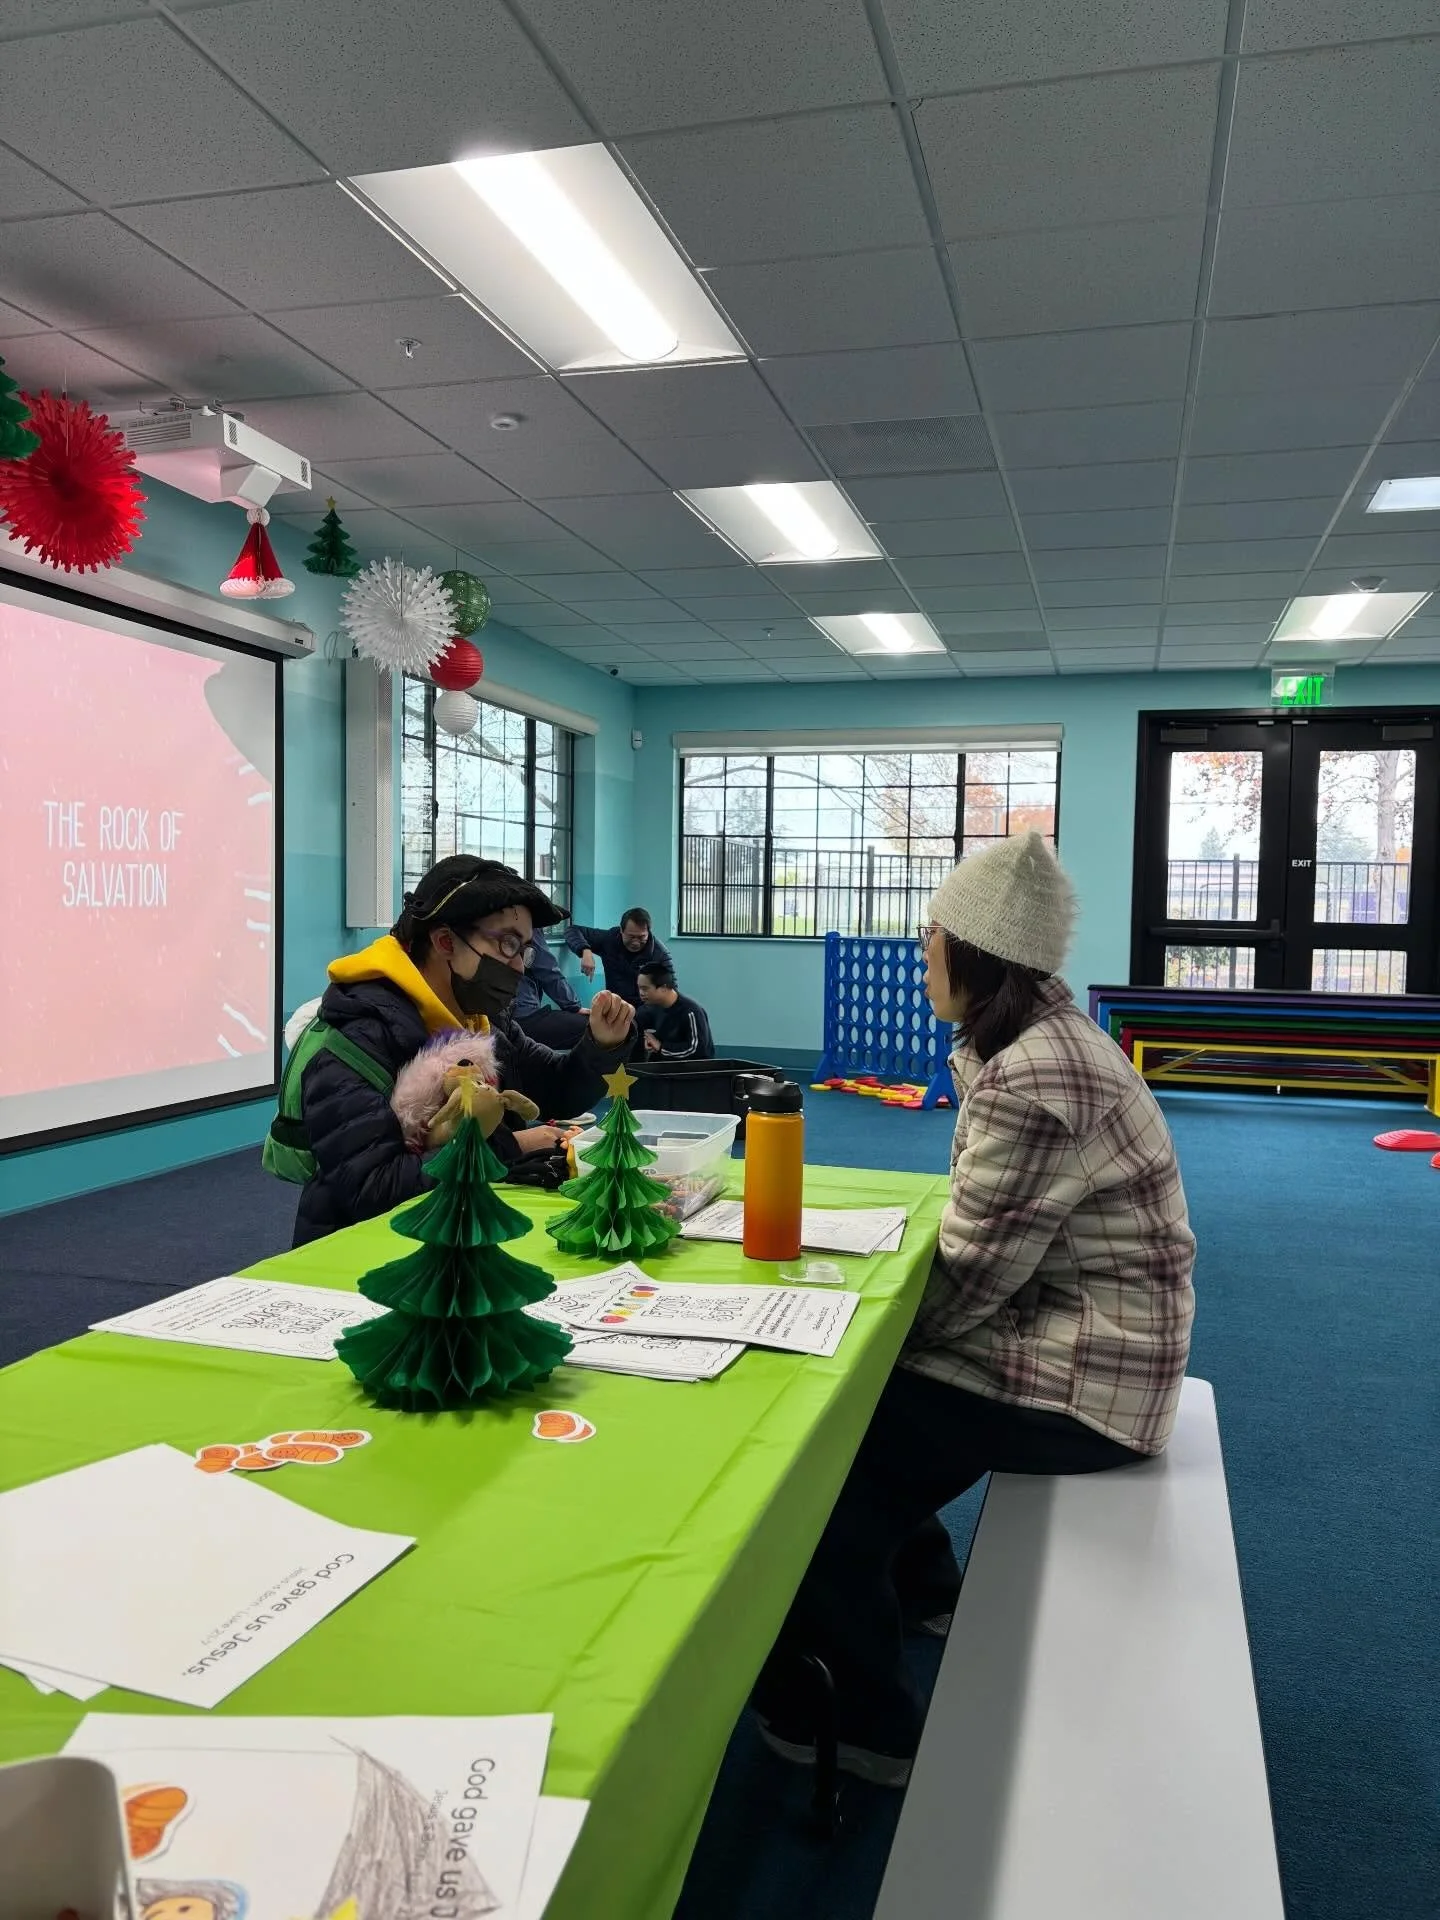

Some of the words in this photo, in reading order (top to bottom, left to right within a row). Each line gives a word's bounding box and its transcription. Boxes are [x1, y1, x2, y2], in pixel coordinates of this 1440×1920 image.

[1282, 676, 1324, 705] EXIT
[43, 800, 86, 849] THE
[100, 805, 150, 851] ROCK
[159, 810, 185, 851] OF
[1291, 859, 1312, 868] EXIT
[62, 860, 167, 907] SALVATION
[313, 1552, 356, 1580] God
[270, 1579, 318, 1613] gave
[244, 1614, 275, 1632] us
[181, 1632, 253, 1677] Jesus.
[463, 1757, 496, 1800] God
[445, 1807, 478, 1863] gave
[435, 1870, 462, 1900] us
